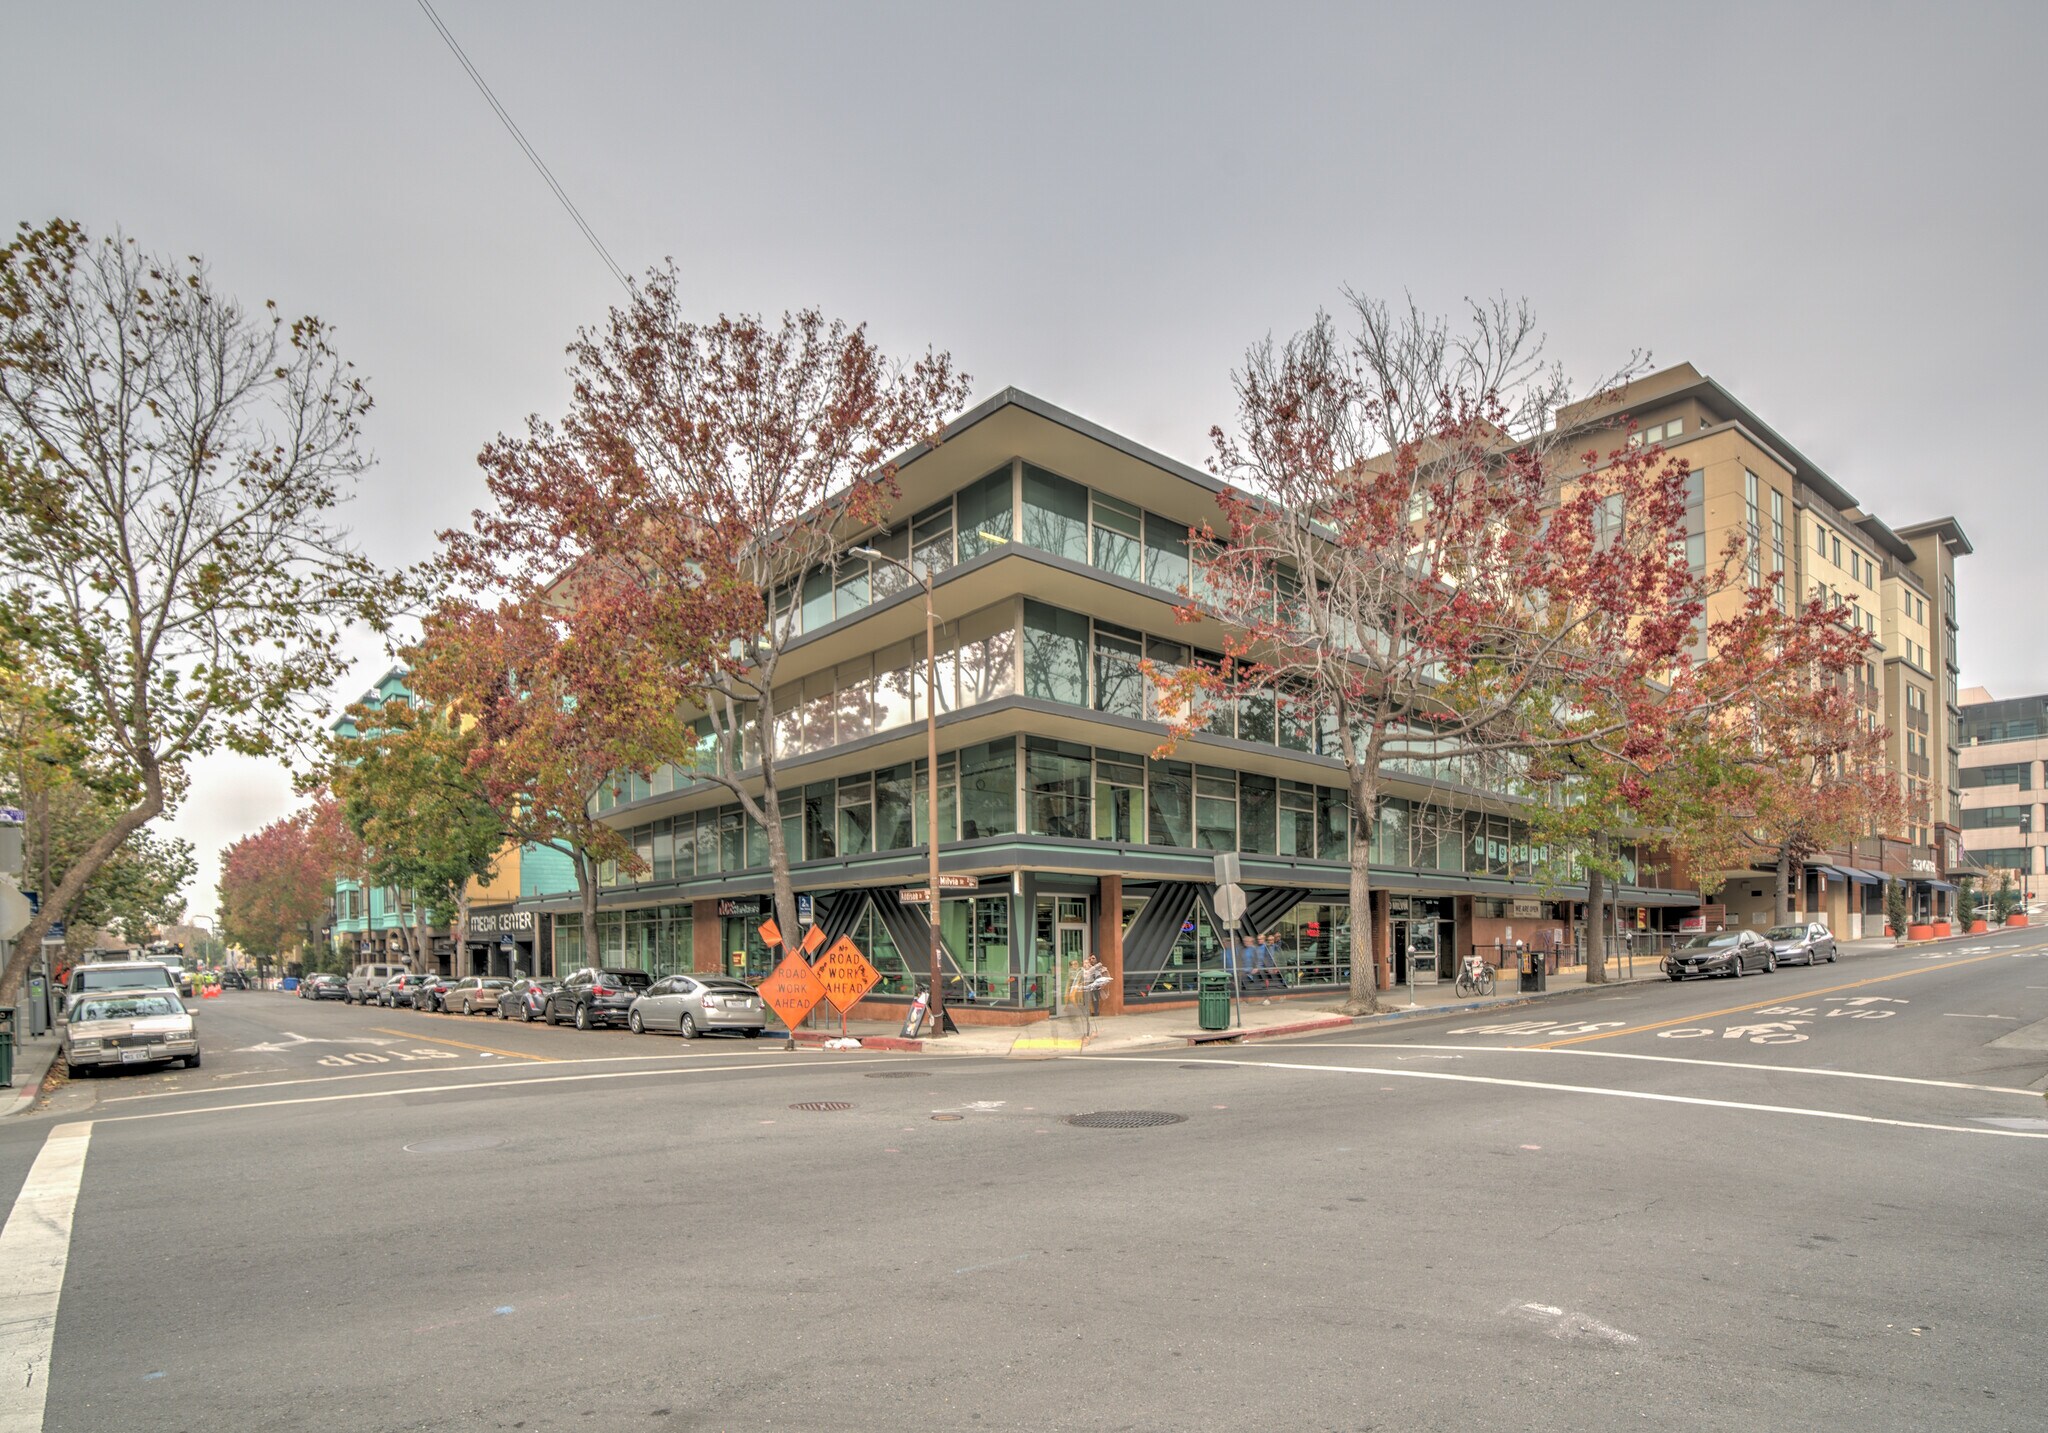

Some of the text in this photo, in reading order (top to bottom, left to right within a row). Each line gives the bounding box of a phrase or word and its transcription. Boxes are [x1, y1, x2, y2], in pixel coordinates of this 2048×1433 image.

[940, 876, 959, 886] Milvia
[471, 911, 532, 931] MEDIA CENTER
[829, 953, 860, 965] ROAD
[778, 969, 807, 979] ROAD
[829, 968, 859, 979] WORK
[777, 984, 807, 994] WORK
[826, 983, 863, 994] AHEAD
[774, 998, 811, 1009] AHEAD
[1754, 1006, 1896, 1019] BLVD
[316, 1049, 460, 1066] STOP
